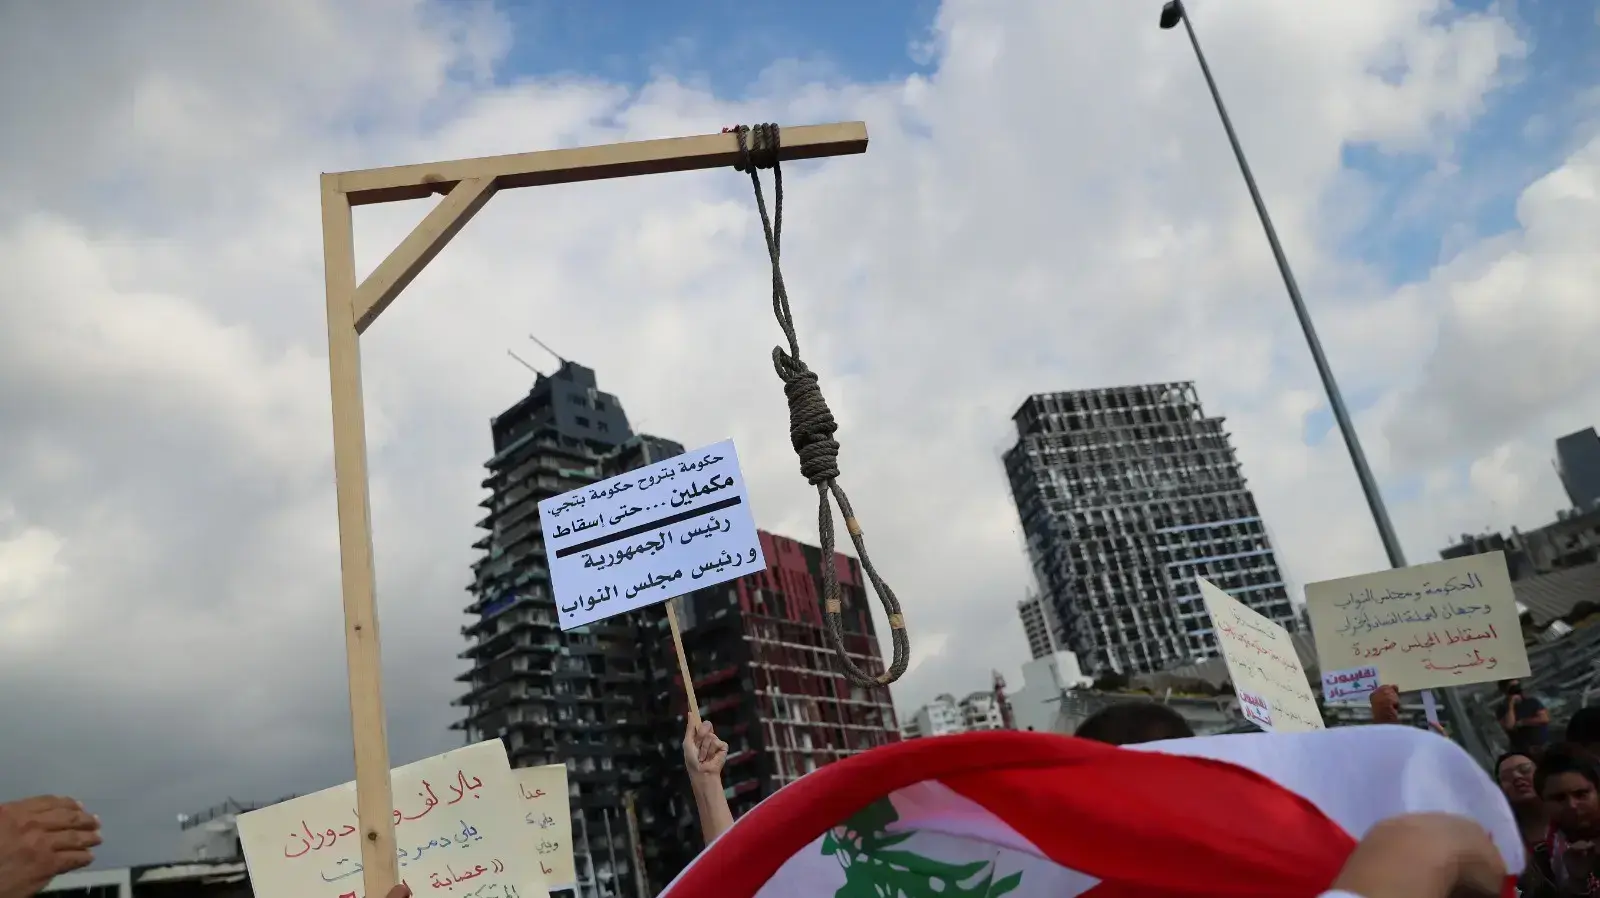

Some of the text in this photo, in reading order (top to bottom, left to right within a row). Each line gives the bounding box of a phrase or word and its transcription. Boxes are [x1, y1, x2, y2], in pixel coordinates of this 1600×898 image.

[679, 453, 724, 474] حكومة
[589, 480, 634, 501] حكومة
[637, 468, 676, 491] بتروح
[670, 474, 735, 507] مكملين
[552, 514, 605, 540] إسقاط
[583, 516, 731, 571] رئيس الجمهورية
[625, 568, 683, 599] مجلس
[1422, 572, 1484, 596] الحكومة
[561, 584, 619, 618] النواب
[1333, 588, 1374, 610] النواب
[1351, 637, 1397, 659] ضرورة
[1400, 631, 1441, 653] المجلس
[284, 820, 356, 859] دوران
